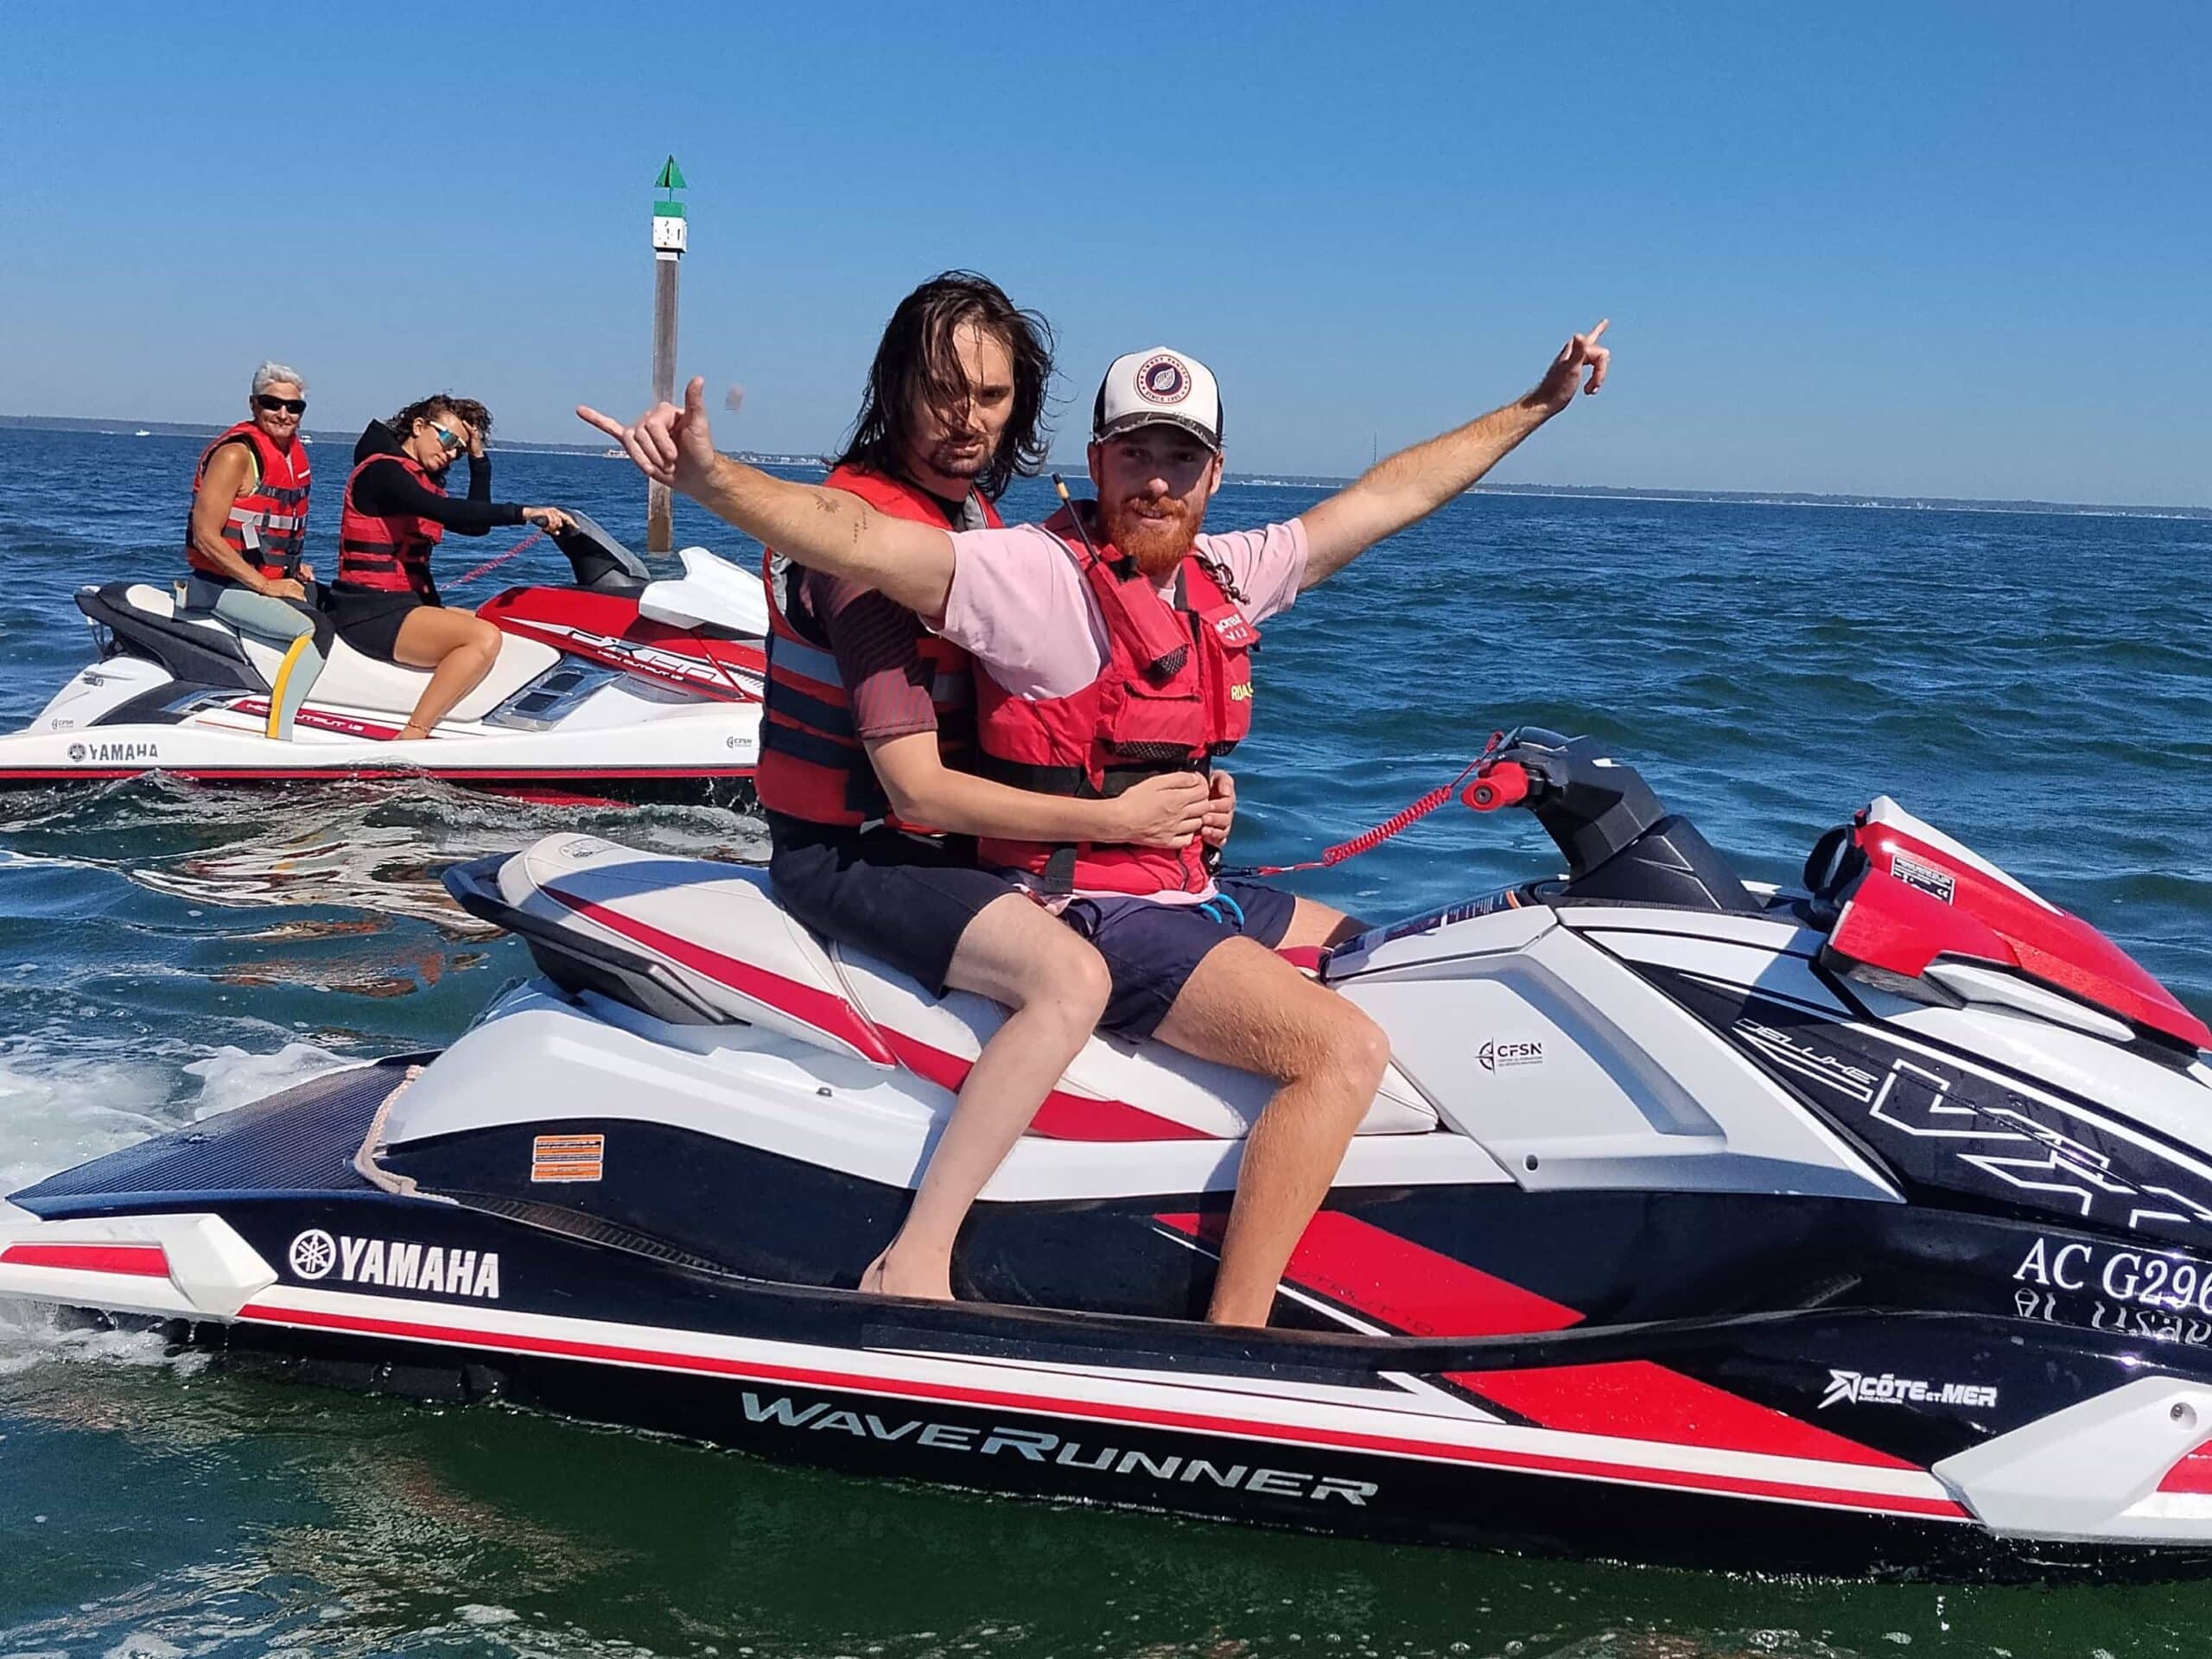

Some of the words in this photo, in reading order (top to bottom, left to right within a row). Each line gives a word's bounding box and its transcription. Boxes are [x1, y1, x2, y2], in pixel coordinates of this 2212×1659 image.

[89, 743, 159, 761] YAMAHA
[1497, 1042, 1542, 1058] CFSN
[1734, 1017, 1879, 1084] DELUXE
[340, 1235, 499, 1300] YAMAHA
[2012, 1236, 2093, 1290] AC
[1859, 1373, 1929, 1402] CÔTE
[1941, 1382, 1999, 1408] MER
